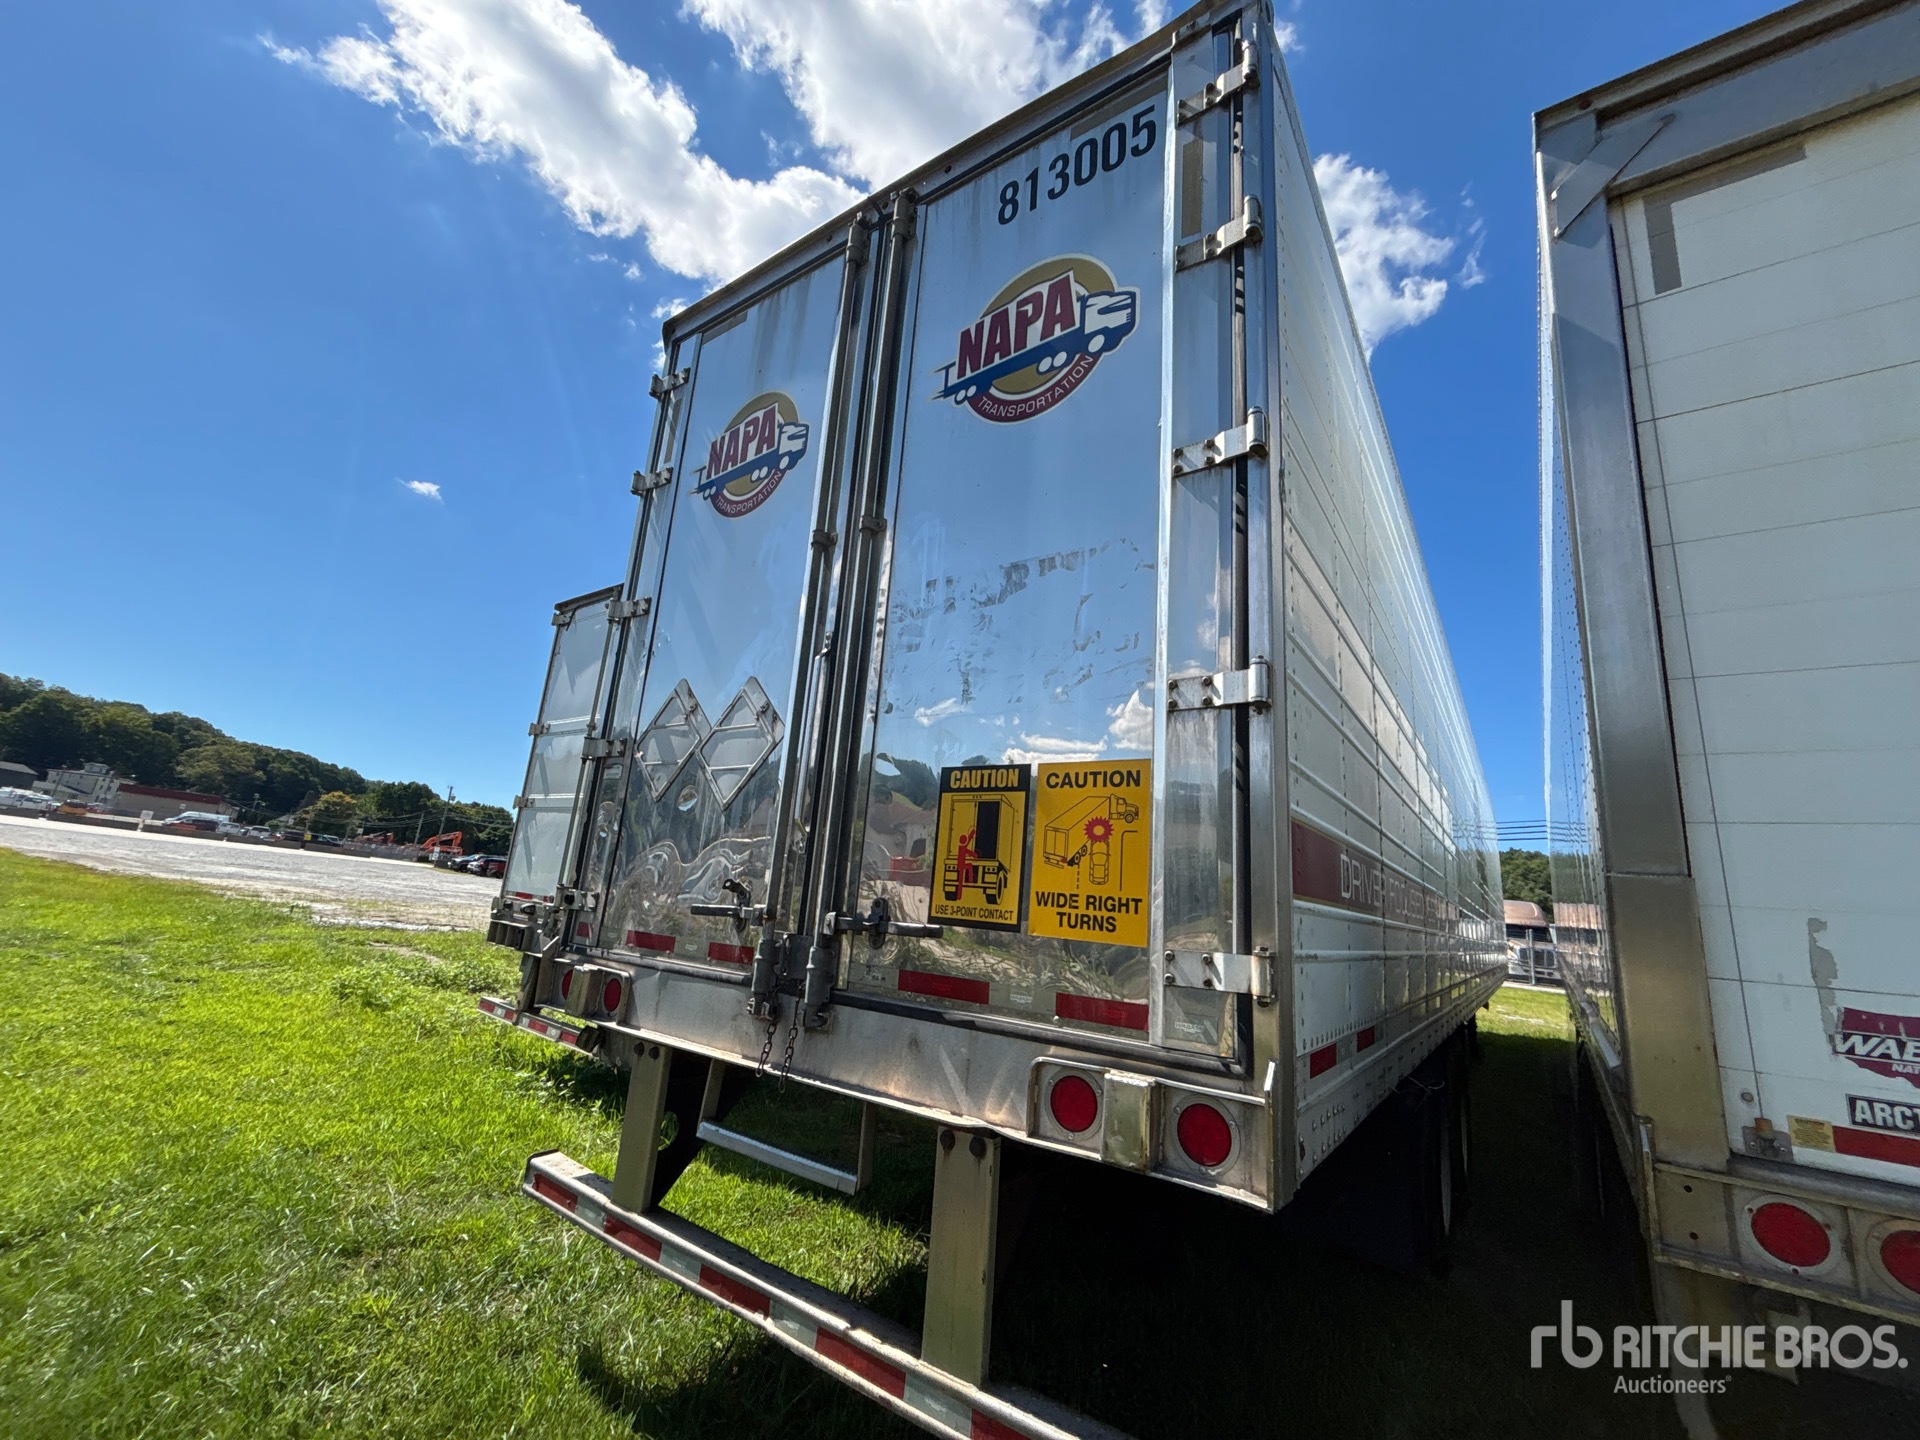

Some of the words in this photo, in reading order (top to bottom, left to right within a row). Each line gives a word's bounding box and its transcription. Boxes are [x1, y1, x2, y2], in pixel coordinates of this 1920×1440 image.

[998, 104, 1157, 225] 813005
[957, 274, 1077, 380] NAPA
[978, 355, 1094, 417] TRANSPORTATION
[706, 405, 776, 480] NAPA
[715, 471, 782, 514] TRANSPORTATION
[950, 768, 1019, 789] CAUTION
[1046, 770, 1141, 789] CAUTION
[1340, 853, 1386, 908] DRIVER
[935, 904, 949, 915] USE
[950, 905, 977, 917] 3-POINT
[979, 908, 1014, 920] CONTACT
[1035, 891, 1080, 909] WIDE
[1085, 894, 1143, 915] RIGHT
[1056, 911, 1117, 933] TURNS
